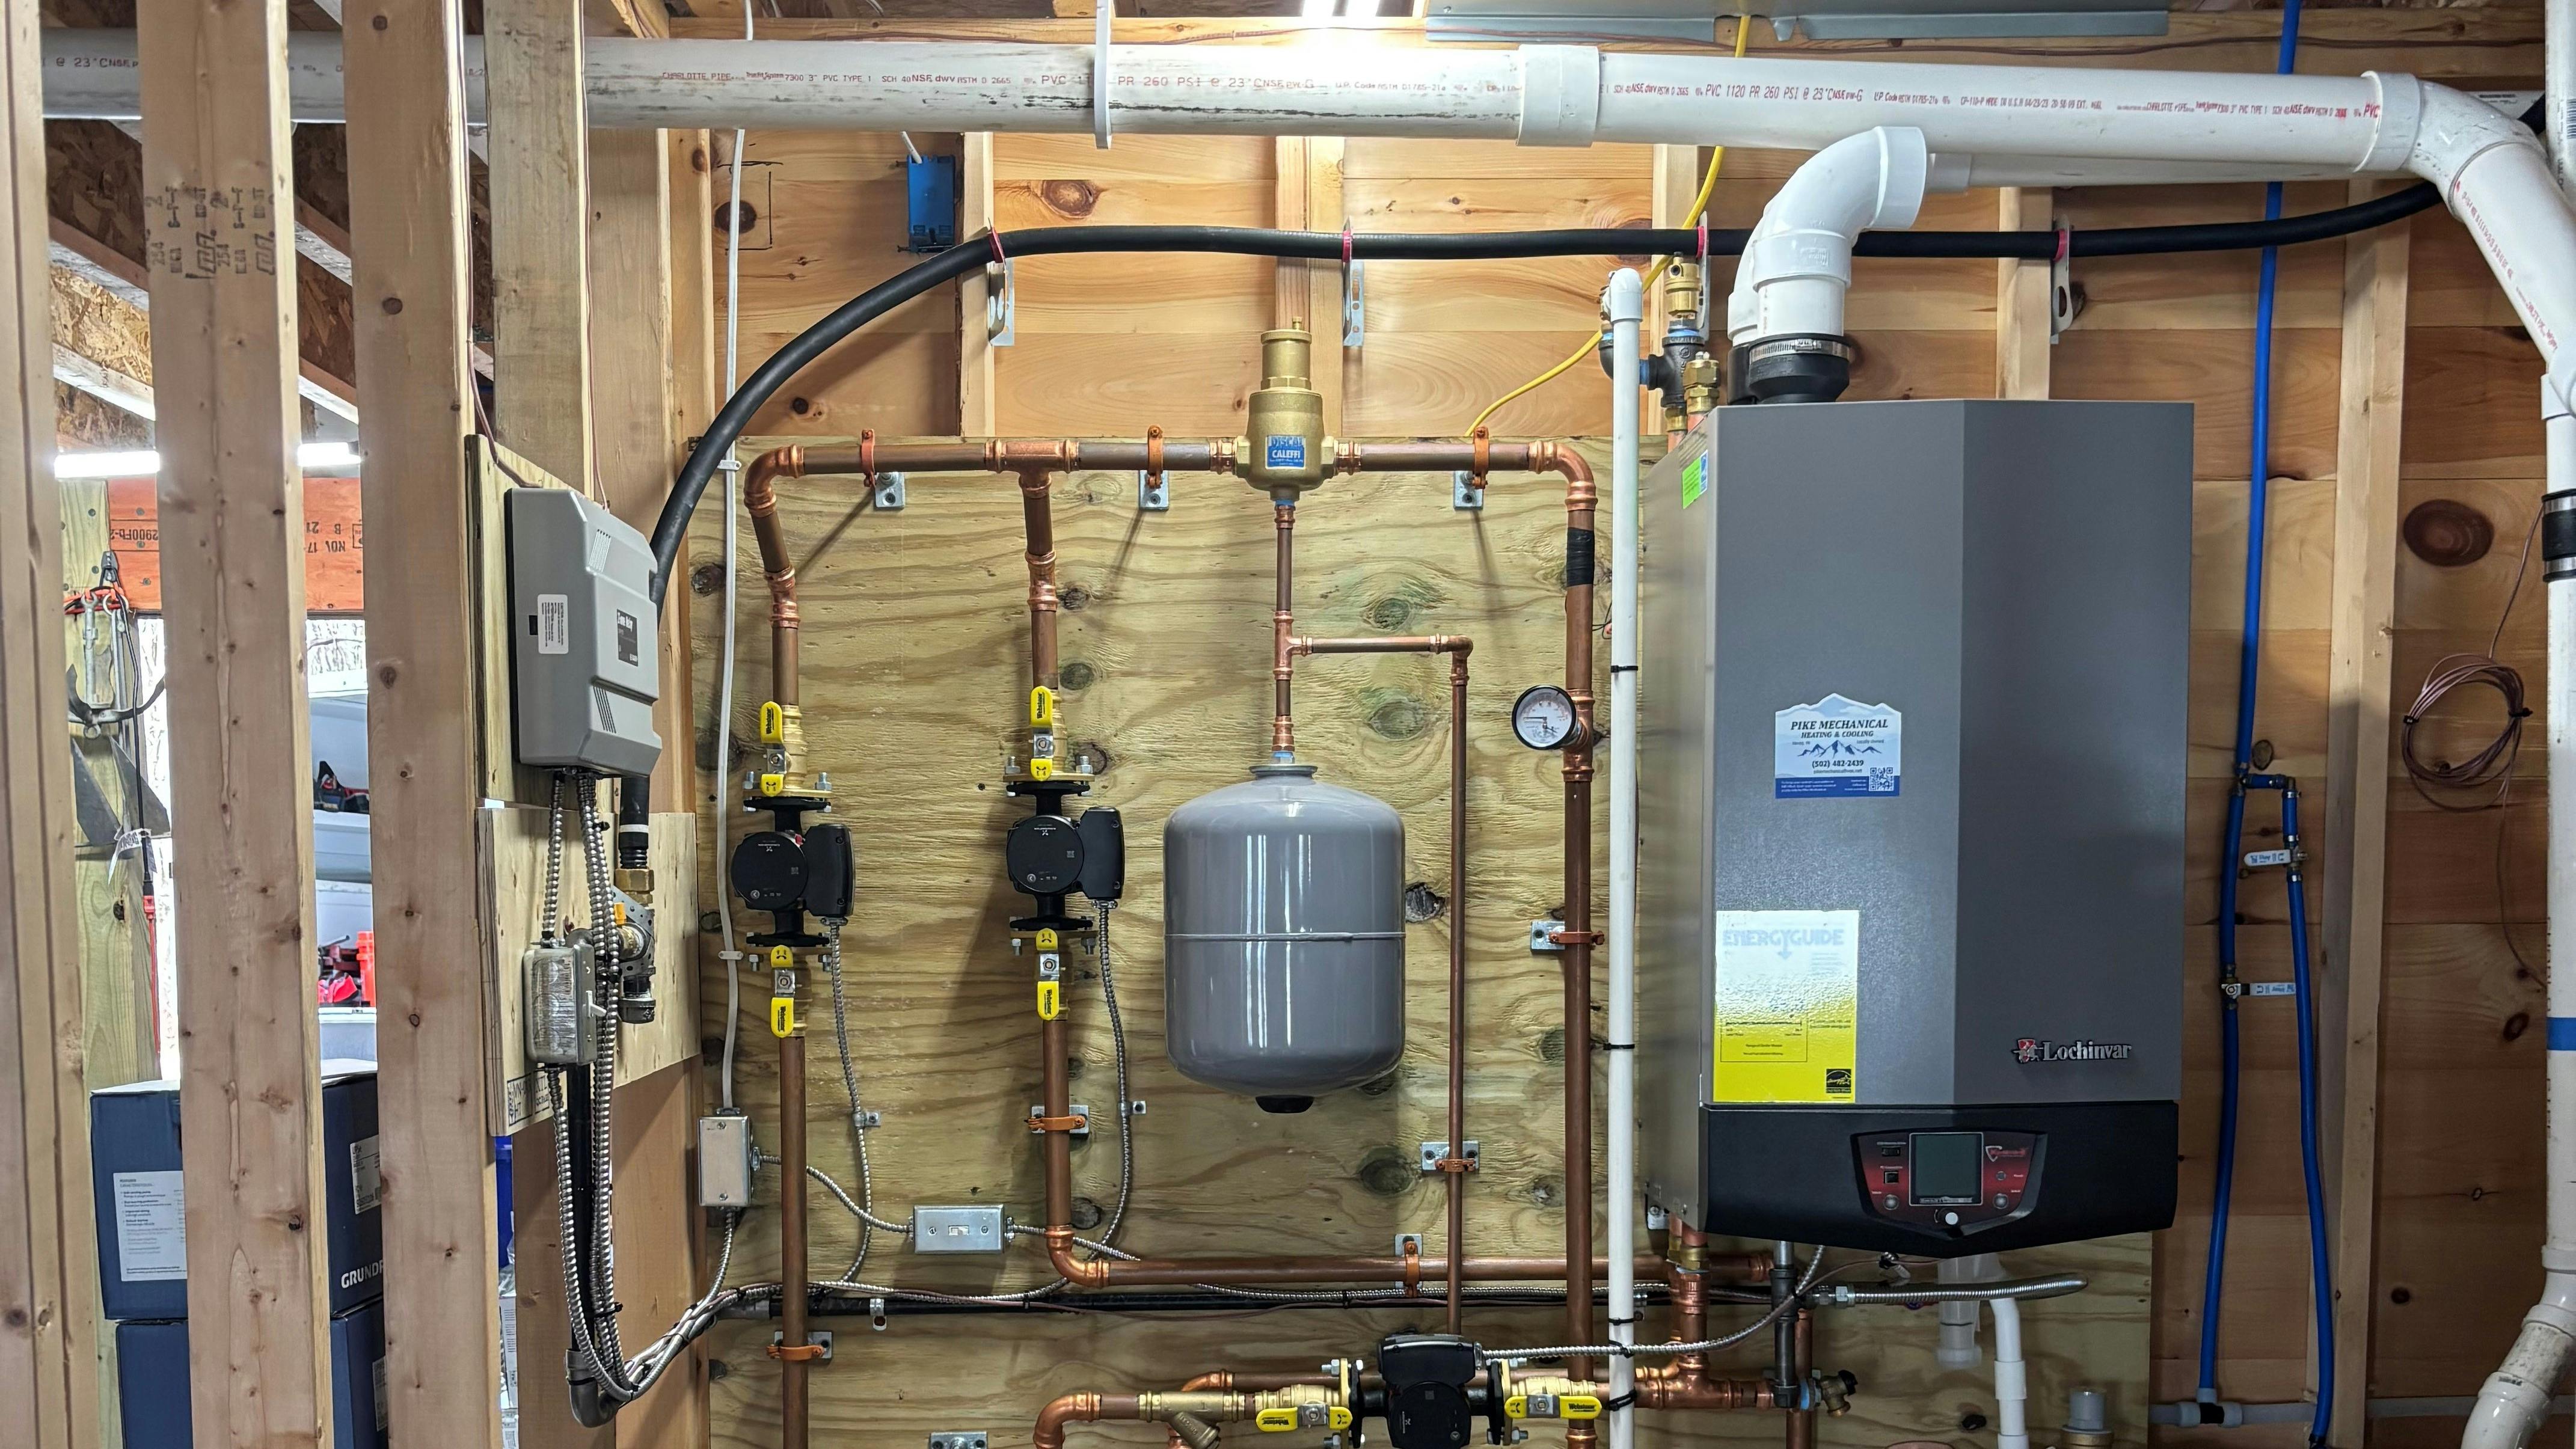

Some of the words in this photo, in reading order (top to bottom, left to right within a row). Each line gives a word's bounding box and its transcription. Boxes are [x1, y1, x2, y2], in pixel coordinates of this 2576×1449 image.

[1041, 75, 1067, 85] PVC
[1118, 76, 1134, 86] PR
[1144, 77, 1168, 86] 260
[1705, 84, 1722, 97] PVC
[1726, 85, 1745, 97] 1120
[1749, 85, 1761, 98] PR
[1764, 86, 1779, 99] 260
[1783, 87, 1799, 100] PSI
[1791, 721, 1817, 730] PIKE
[1819, 719, 1889, 729] MECHANICAL
[2043, 1041, 2132, 1061] Lochinvar
